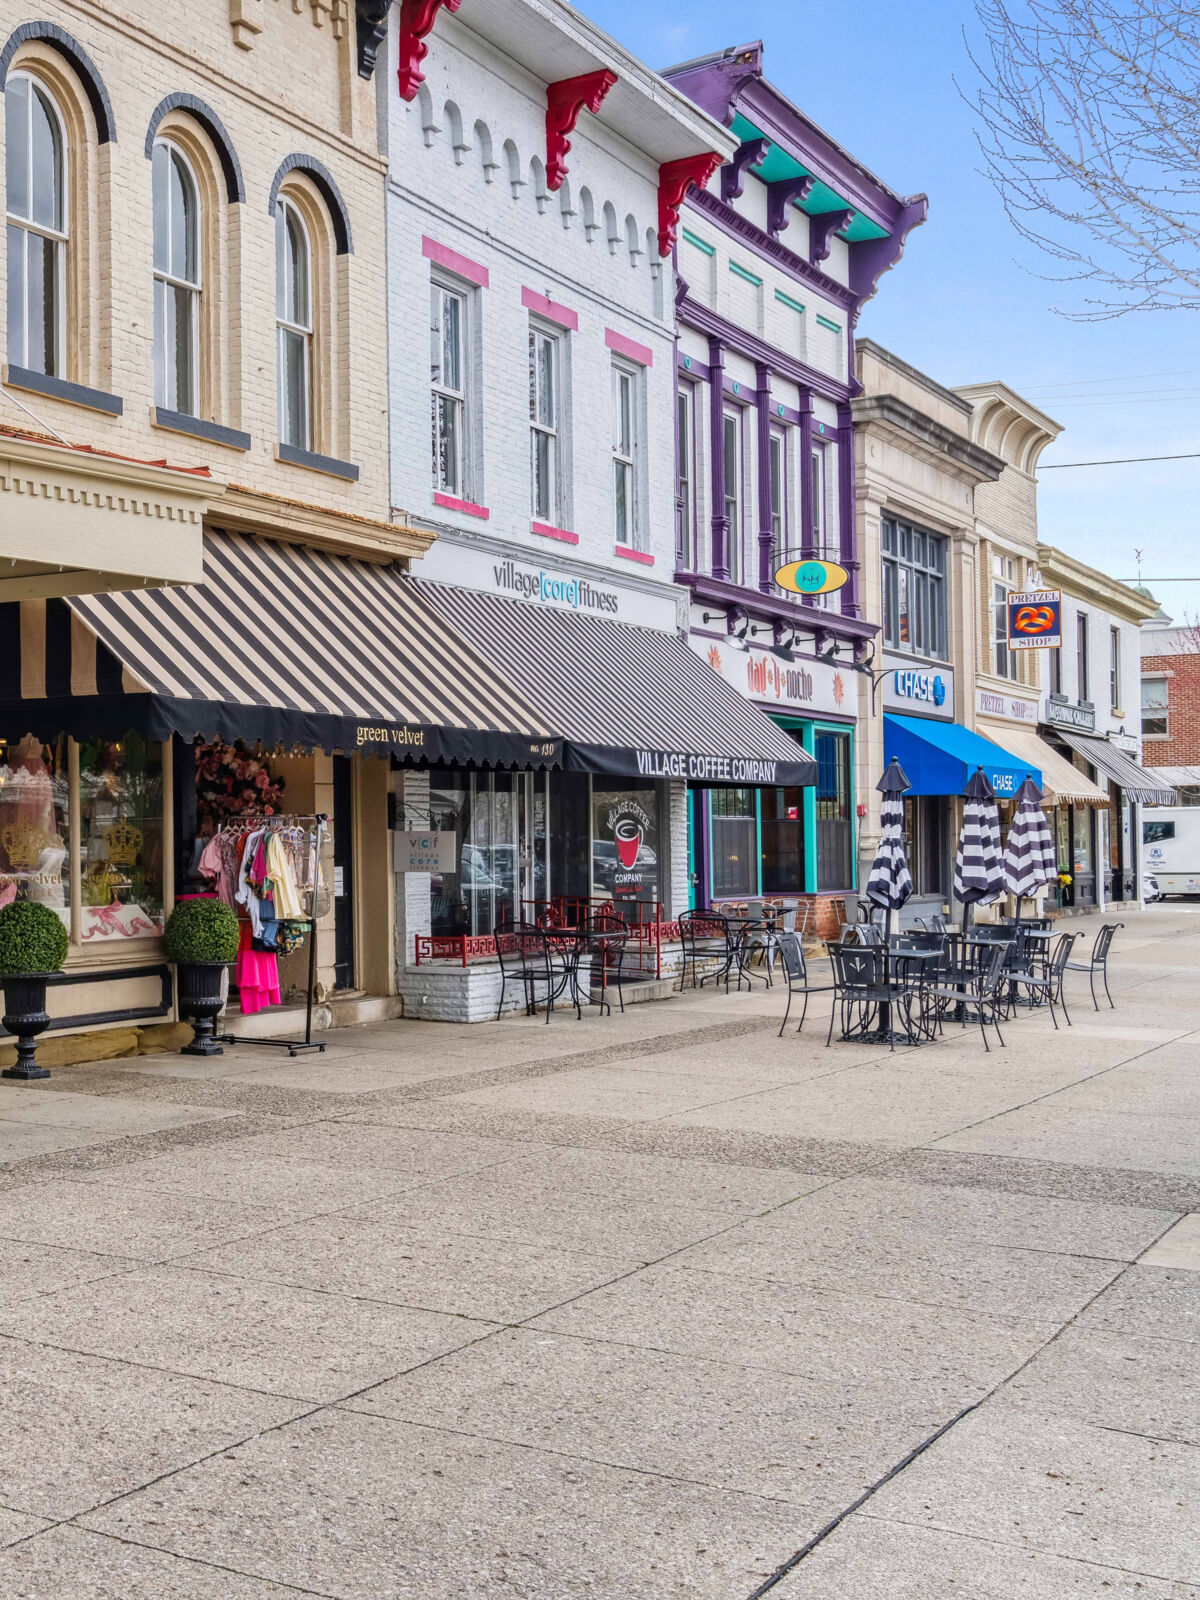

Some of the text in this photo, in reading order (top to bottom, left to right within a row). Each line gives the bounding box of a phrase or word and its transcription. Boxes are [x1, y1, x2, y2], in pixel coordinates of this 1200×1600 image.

[1010, 592, 1059, 604] PRETZEL
[1018, 637, 1052, 647] SHOP
[894, 670, 934, 702] CHASE
[980, 693, 1006, 715] PRETZEL
[356, 726, 389, 746] green
[391, 725, 425, 746] velvet
[636, 750, 777, 782] VILLAGE COFFEE COMPANY
[992, 774, 1013, 791] CHASE
[628, 801, 651, 831] COFFEE
[614, 873, 643, 884] COMPANY
